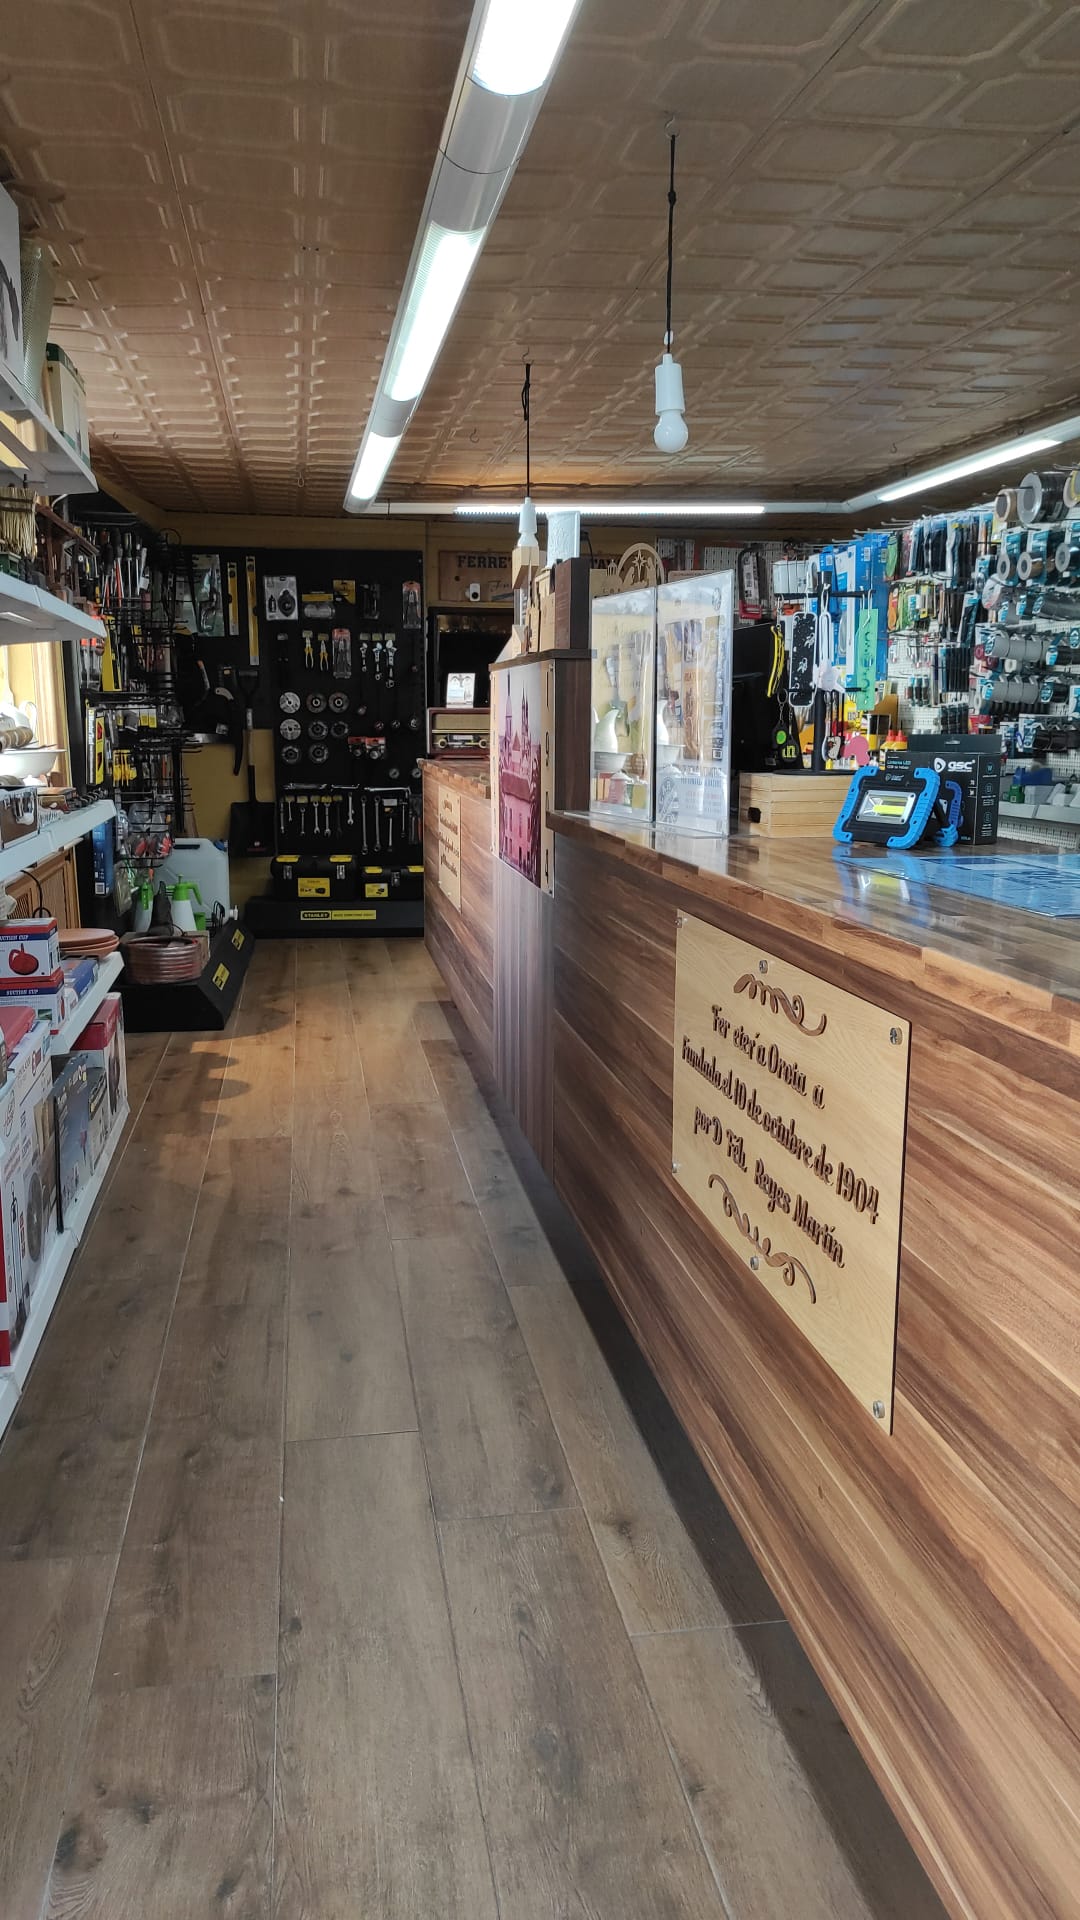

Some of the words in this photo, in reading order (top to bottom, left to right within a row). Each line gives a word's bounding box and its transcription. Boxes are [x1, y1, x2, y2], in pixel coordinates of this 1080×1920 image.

[457, 555, 512, 569] FERRE
[682, 1035, 722, 1091] Fundada
[721, 1069, 733, 1100] el
[734, 1077, 747, 1110] 10
[747, 1088, 762, 1125] de
[762, 1112, 813, 1169] octubre
[814, 1143, 834, 1186] de
[836, 1161, 879, 1224] 1904
[694, 1106, 712, 1134] por
[754, 1157, 791, 1214] Reyes
[792, 1194, 845, 1268] Martín
